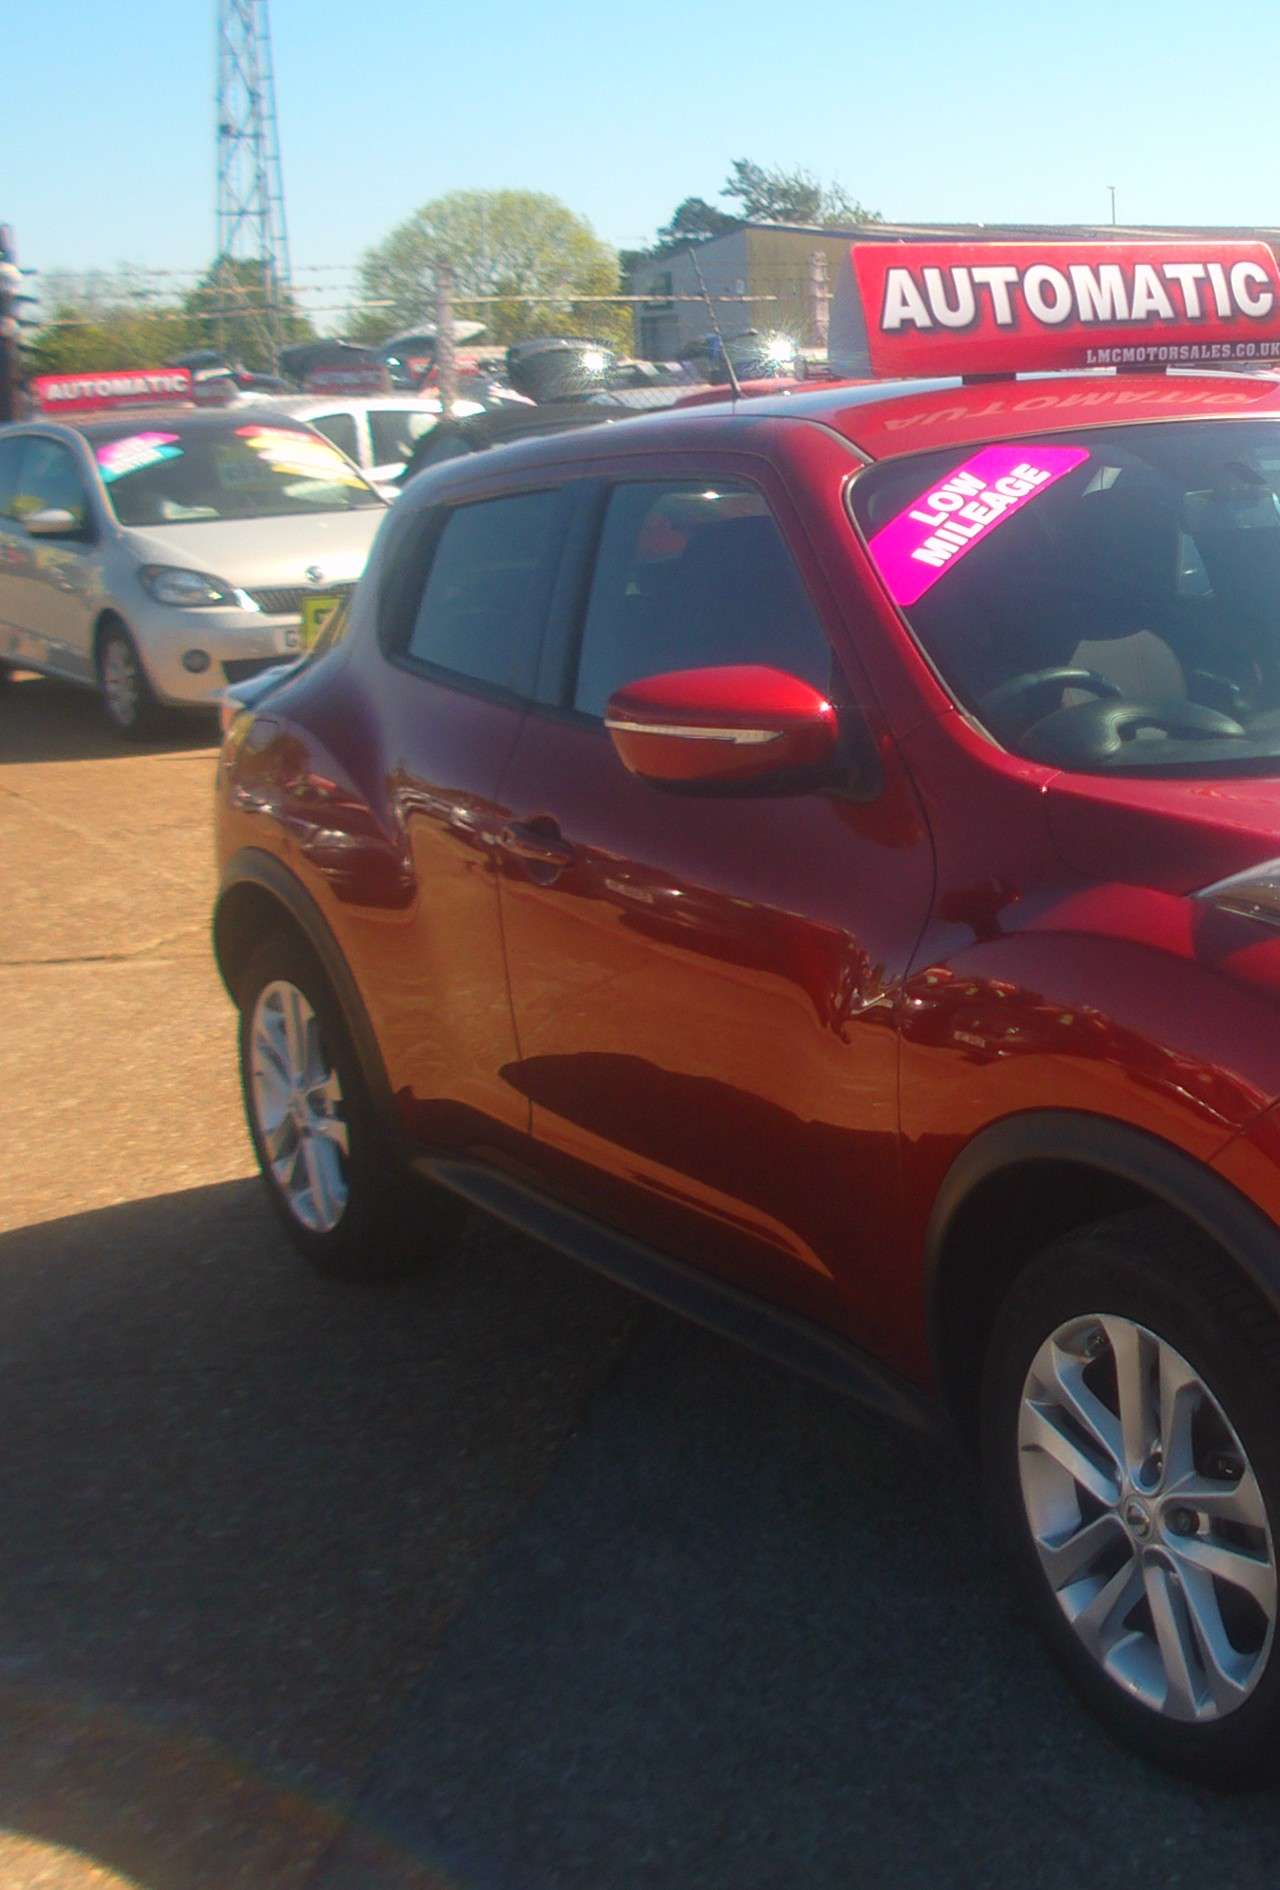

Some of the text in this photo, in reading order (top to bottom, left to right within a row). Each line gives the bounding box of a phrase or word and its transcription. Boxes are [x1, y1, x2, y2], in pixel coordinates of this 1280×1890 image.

[881, 261, 1273, 330] AUTOMATIC
[1086, 341, 1280, 364] LMCMOTORSALES.CO.UK
[47, 374, 188, 400] AUTOMATIC
[909, 471, 988, 527] LOW
[911, 463, 1052, 567] MILEAGE
